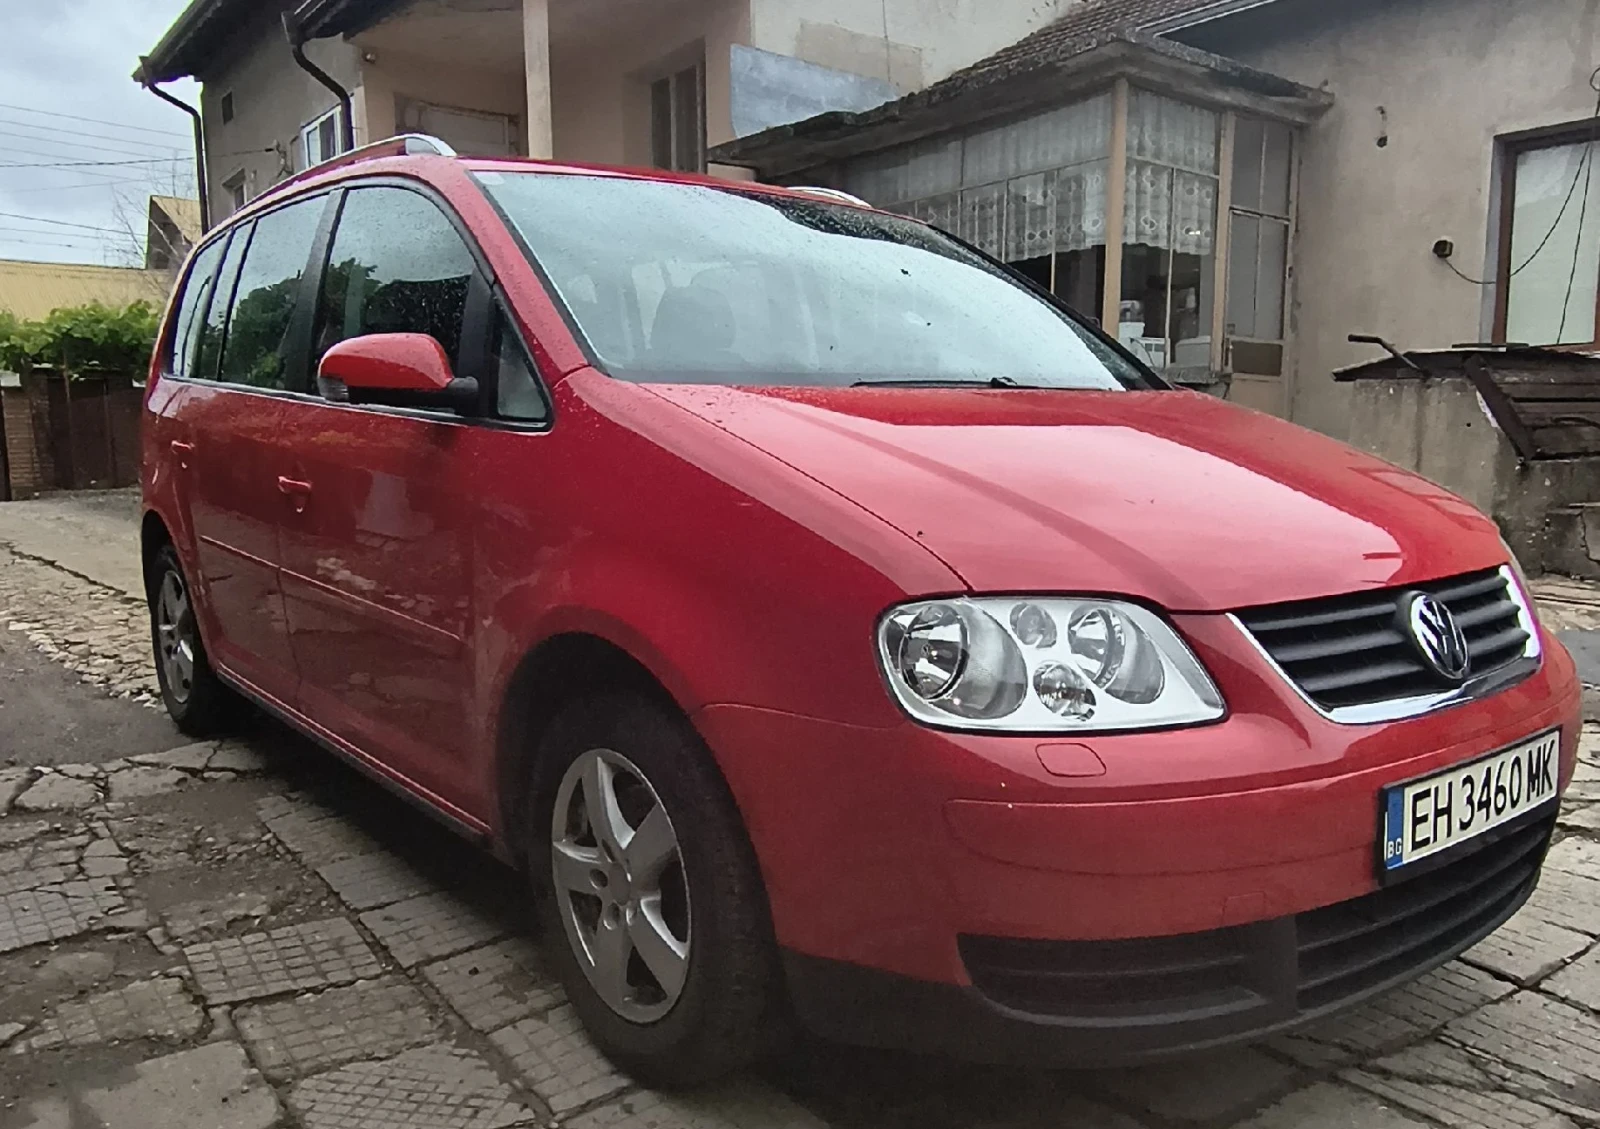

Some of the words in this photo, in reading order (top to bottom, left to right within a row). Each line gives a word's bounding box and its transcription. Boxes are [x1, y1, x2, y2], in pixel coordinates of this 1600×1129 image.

[1411, 781, 1453, 852] EH
[1458, 755, 1522, 831] 3460
[1526, 739, 1555, 802] MK
[1387, 837, 1402, 859] BG
